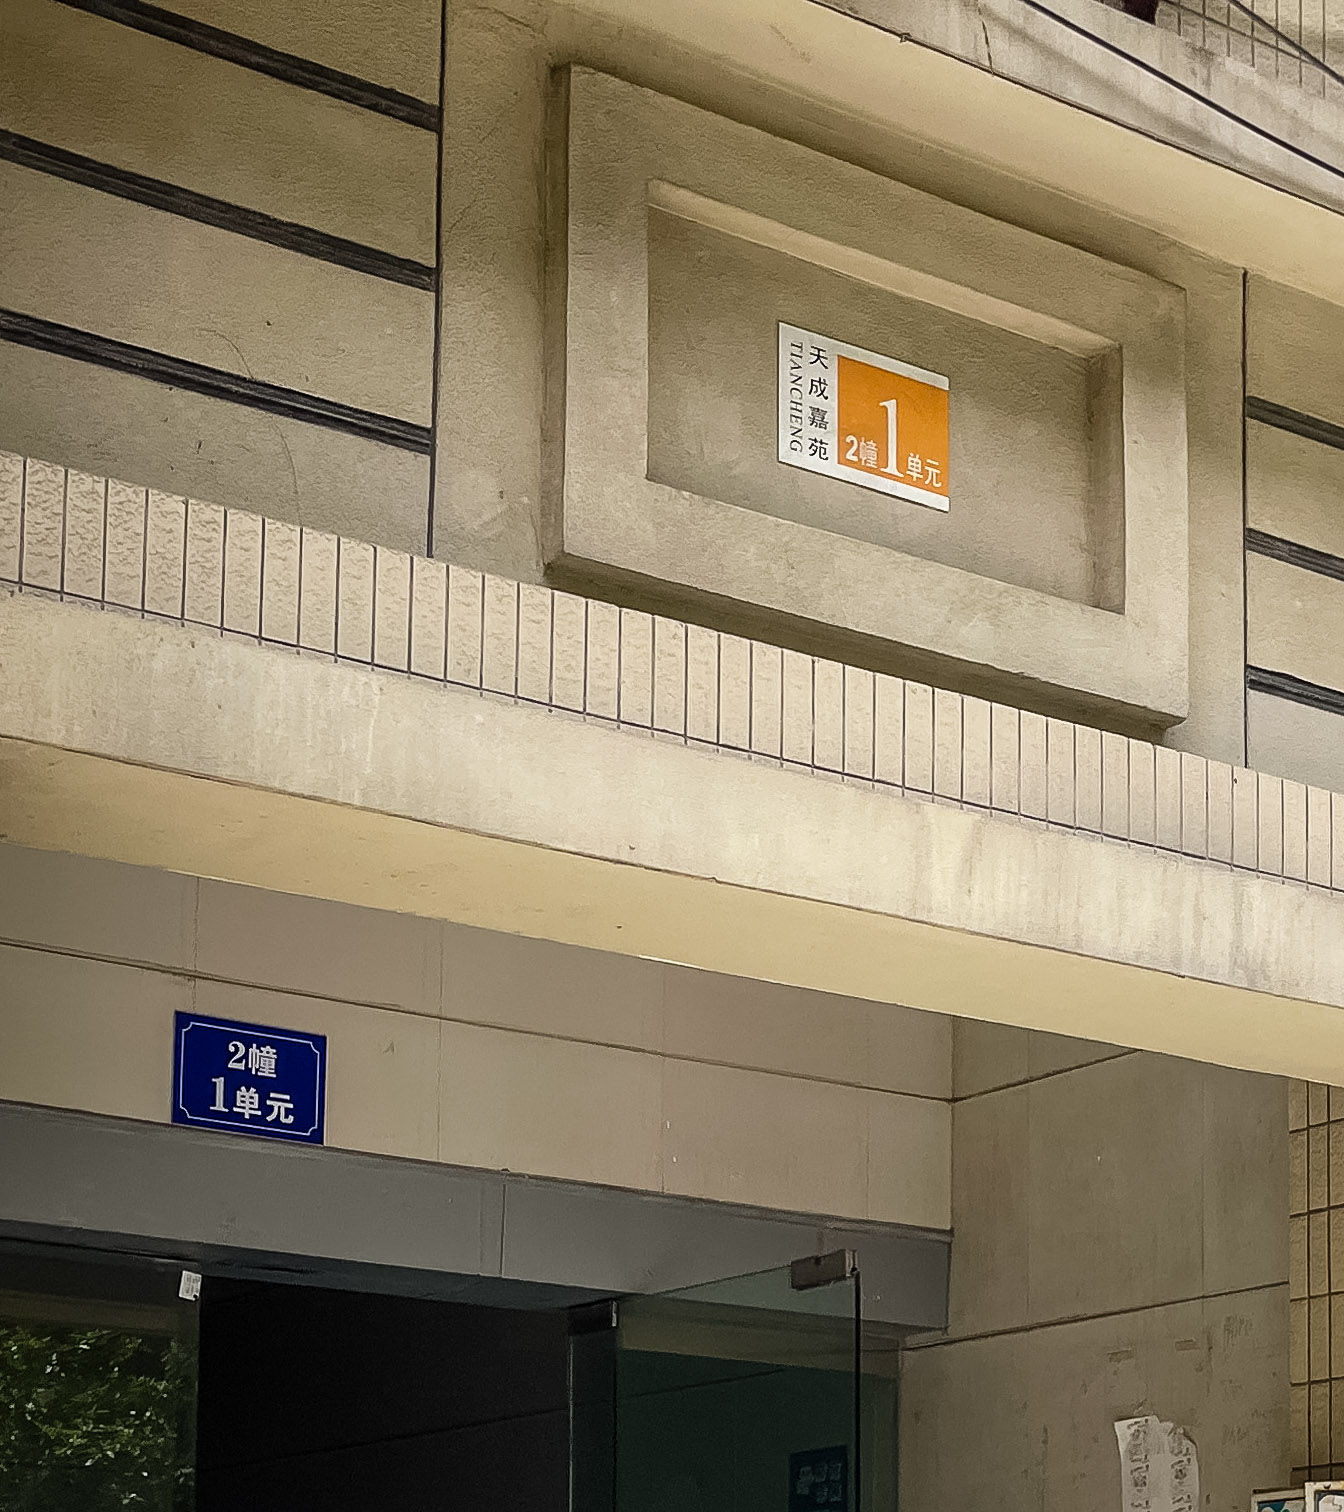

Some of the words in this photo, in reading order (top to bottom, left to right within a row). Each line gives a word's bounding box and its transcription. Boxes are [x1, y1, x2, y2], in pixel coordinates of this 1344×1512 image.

[789, 341, 804, 453] TIANCHENG
[808, 345, 830, 462] 天成嘉苑
[227, 1040, 278, 1078] 2幢
[209, 1076, 295, 1124] 1单元
